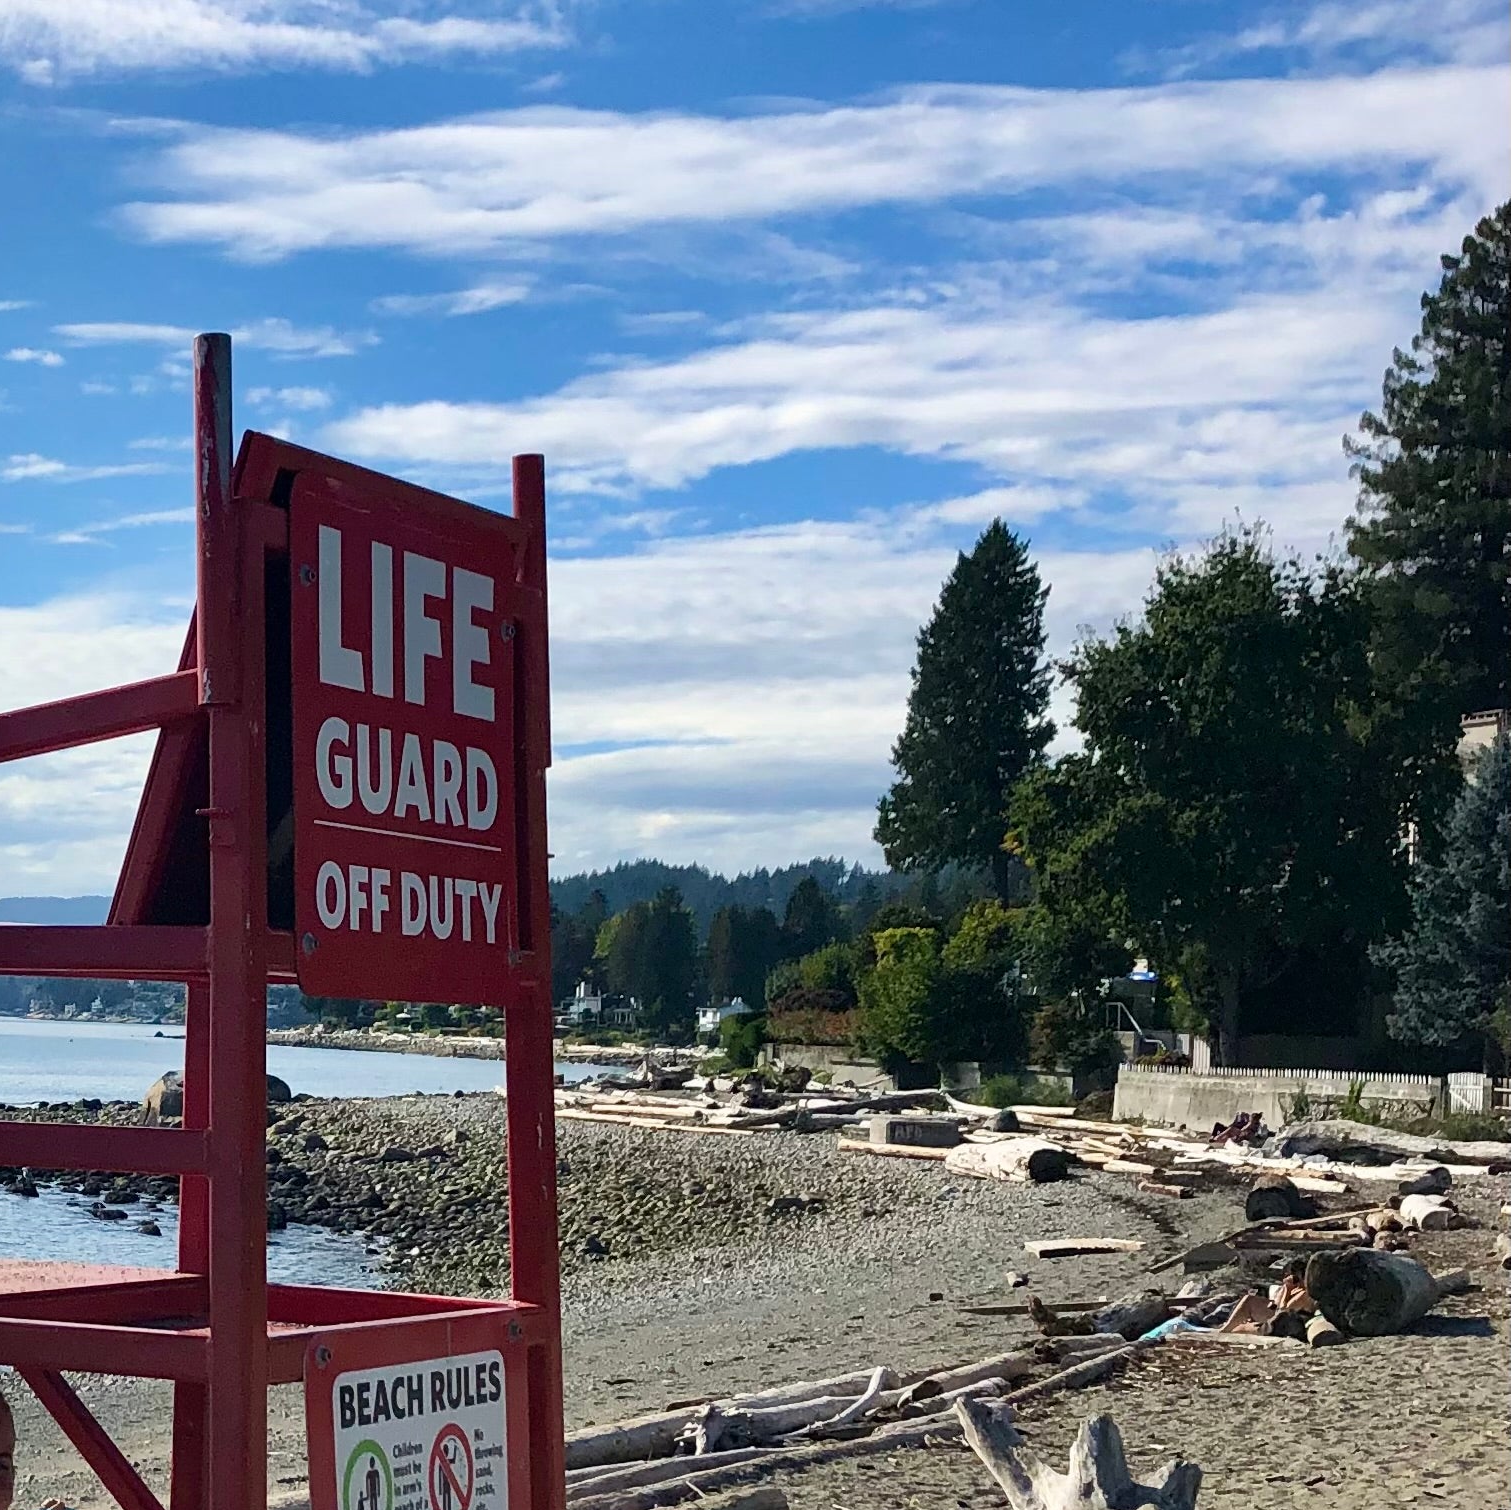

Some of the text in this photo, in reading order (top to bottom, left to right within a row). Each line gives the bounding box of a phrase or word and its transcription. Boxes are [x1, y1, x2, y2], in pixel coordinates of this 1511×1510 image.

[318, 524, 495, 722] LIFE
[316, 717, 498, 831] GUARD
[316, 861, 502, 944] OFF DUTY
[339, 1361, 502, 1430] BEACH RULES
[474, 1428, 484, 1442] No
[393, 1442, 423, 1459] Children
[475, 1444, 503, 1459] throwing
[393, 1460, 421, 1478] must be
[394, 1479, 422, 1496] in arm's
[416, 1496, 423, 1510] of
